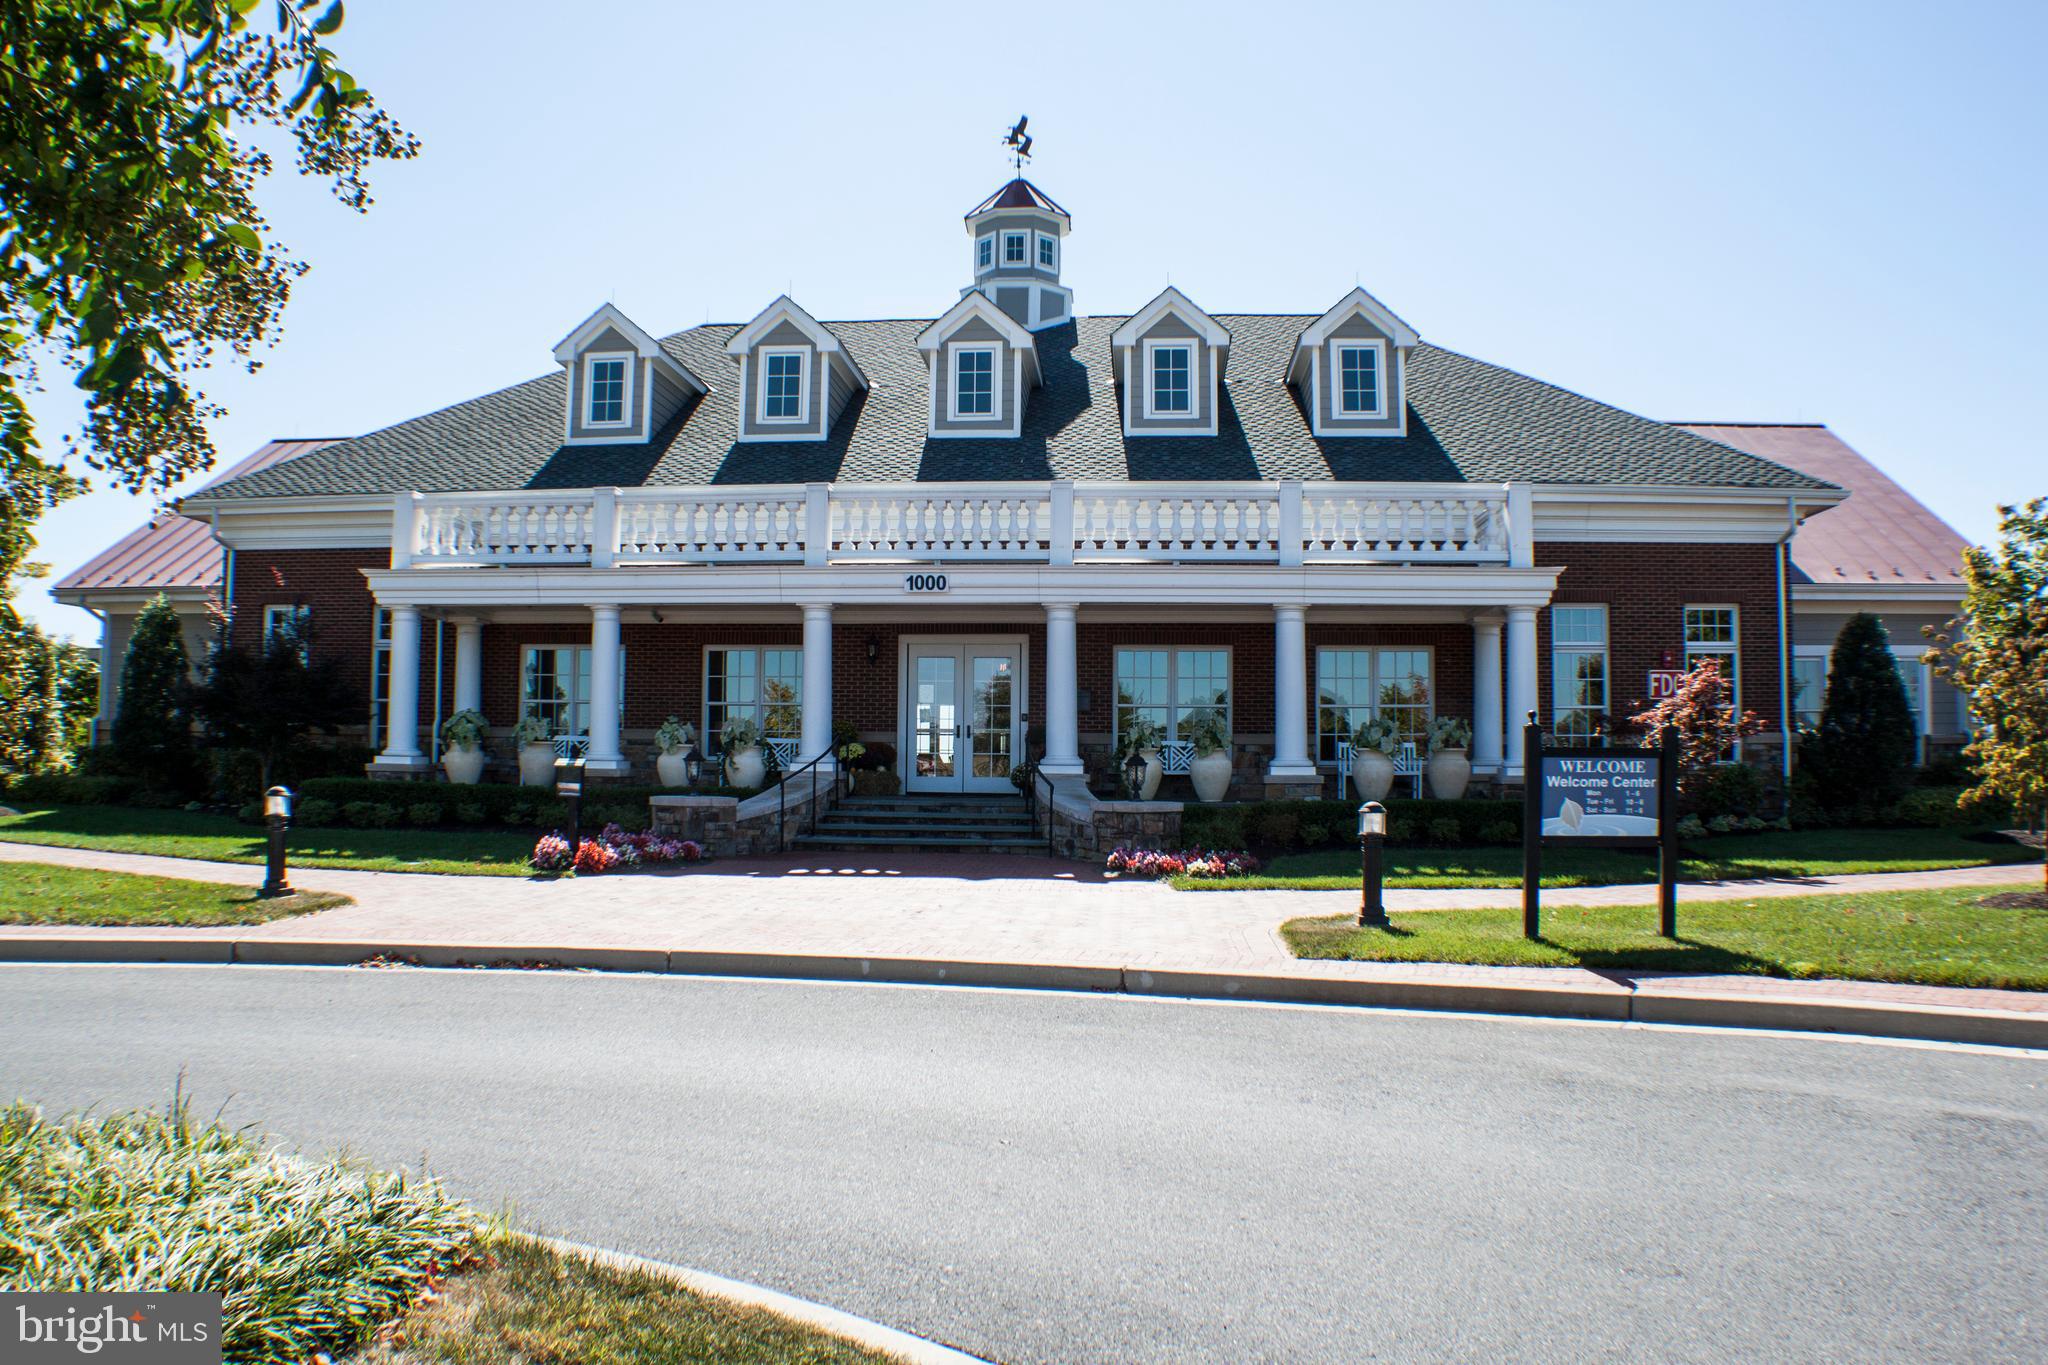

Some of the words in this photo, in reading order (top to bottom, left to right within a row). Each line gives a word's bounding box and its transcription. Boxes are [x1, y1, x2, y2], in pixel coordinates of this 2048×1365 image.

[906, 575, 946, 590] 1000
[1560, 760, 1647, 773] WELCOME
[1546, 776, 1608, 788] Welcome
[1612, 776, 1656, 788] Center
